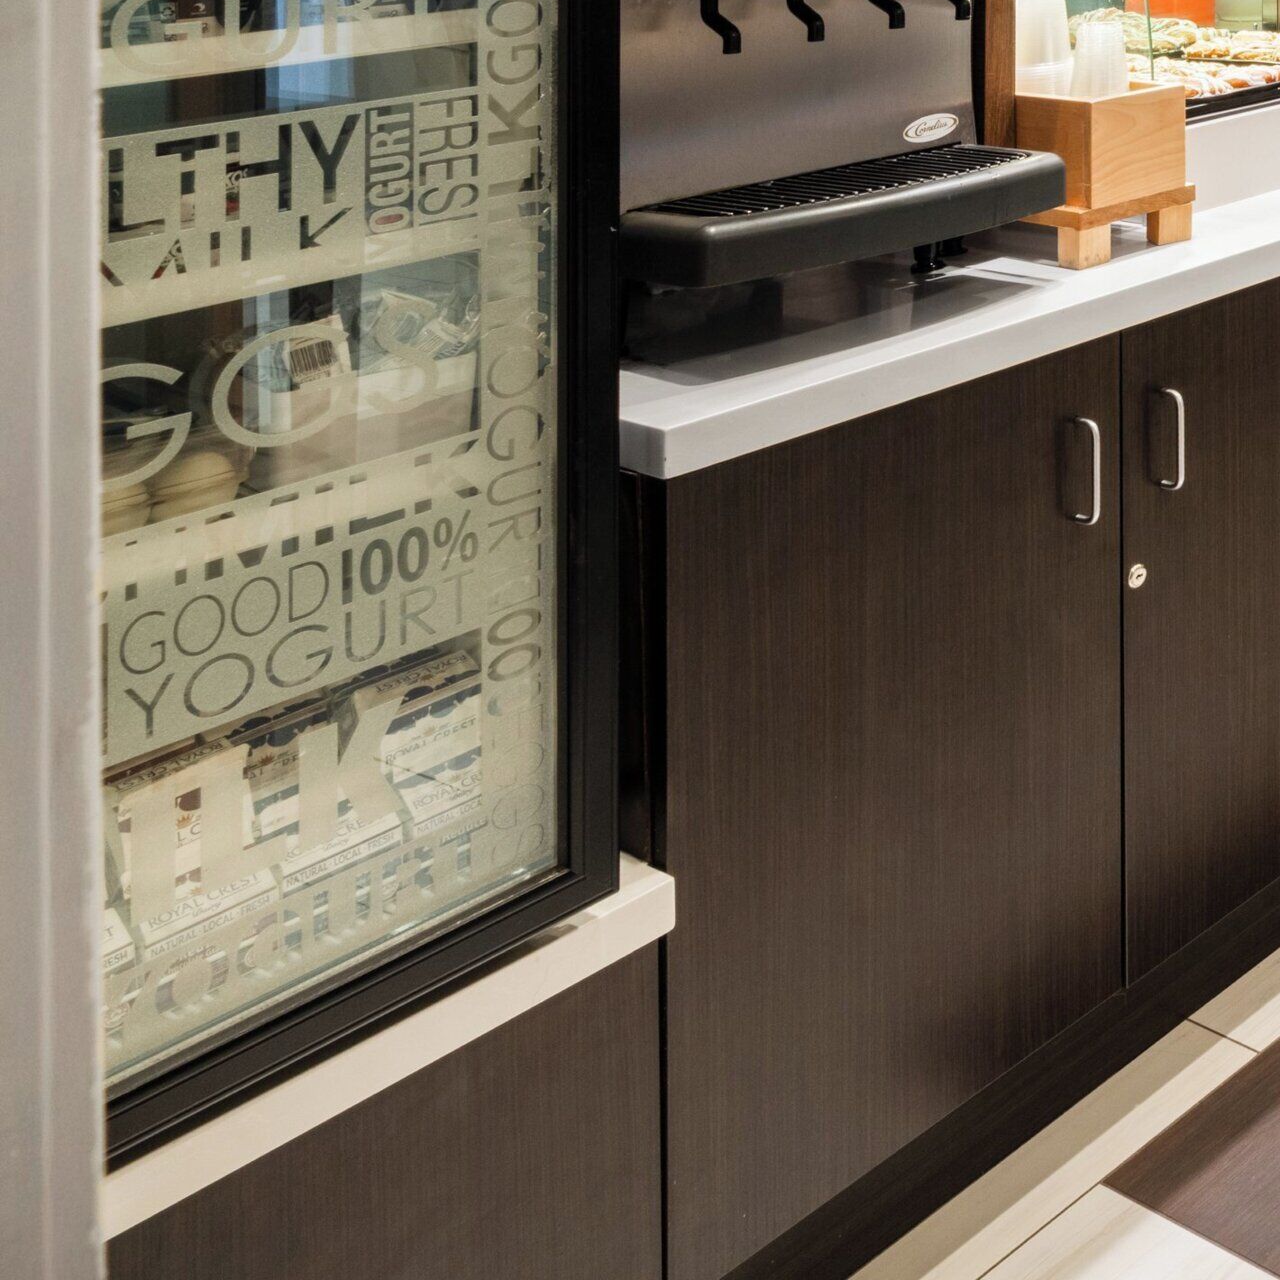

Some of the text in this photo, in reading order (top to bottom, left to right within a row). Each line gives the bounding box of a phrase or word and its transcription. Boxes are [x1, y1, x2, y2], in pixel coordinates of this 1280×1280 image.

[341, 509, 479, 605] 100%
[120, 560, 329, 675] GOOD
[123, 568, 475, 739] YOGURT
